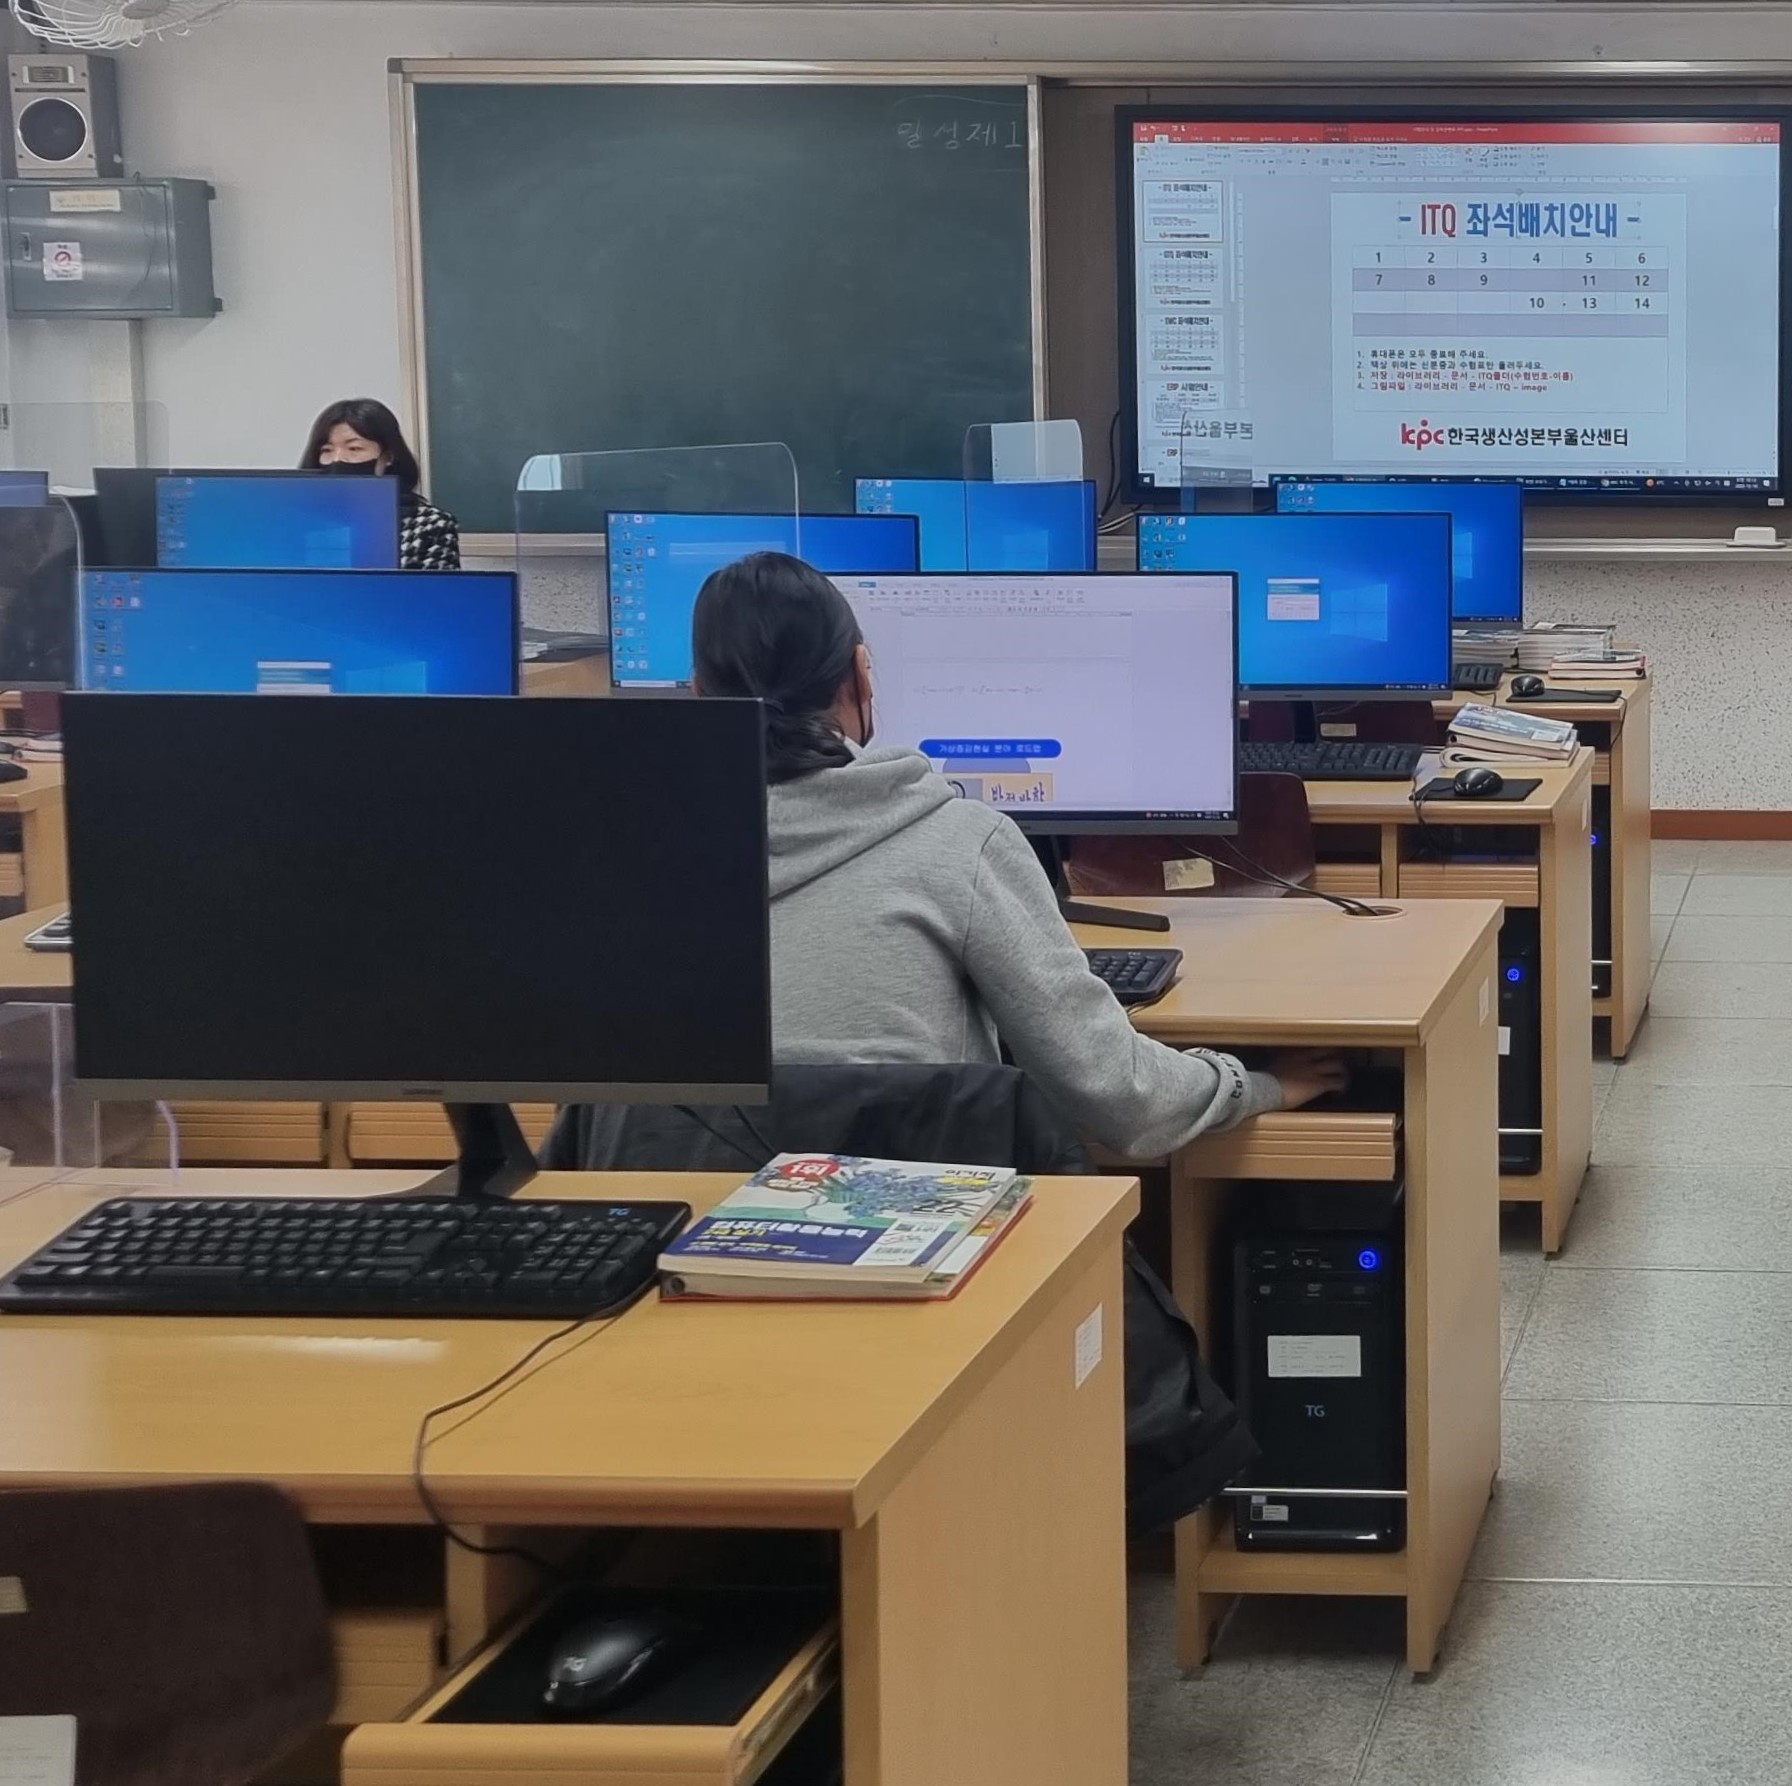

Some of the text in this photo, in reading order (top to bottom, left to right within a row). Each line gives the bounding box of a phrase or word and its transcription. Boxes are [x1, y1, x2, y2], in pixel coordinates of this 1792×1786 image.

[1420, 203, 1457, 238] ITQ
[1466, 202, 1619, 239] 좌석배치안내
[1375, 252, 1382, 264] 1
[1427, 252, 1435, 264] 2
[1480, 252, 1487, 264] 3
[1532, 252, 1541, 264] 4
[1585, 252, 1593, 264] 5
[1638, 252, 1646, 264] 6
[1375, 274, 1382, 286] 7
[1427, 274, 1435, 286] 8
[1480, 274, 1488, 286] 9
[1582, 274, 1596, 286] 11
[1635, 274, 1650, 286] 12
[1530, 297, 1544, 309] 10
[1582, 297, 1597, 309] 13
[1635, 297, 1650, 309] 14
[1371, 372, 1388, 381] 저장
[1397, 372, 1440, 381] 라이브러리
[1451, 372, 1468, 381] 문서
[1371, 382, 1405, 391] 그림파일
[1414, 382, 1458, 391] 라이브러리
[1469, 382, 1486, 391] 문서
[1496, 383, 1511, 392] ITQ
[1522, 384, 1548, 393] image
[1401, 420, 1628, 450] kpc 한국생산성본부울산센터
[790, 1161, 831, 1176] 1위
[945, 1169, 996, 1181] 이기적
[608, 1208, 629, 1216] TG
[710, 1220, 868, 1238] 컴퓨터활용능력
[1305, 1404, 1326, 1417] TG
